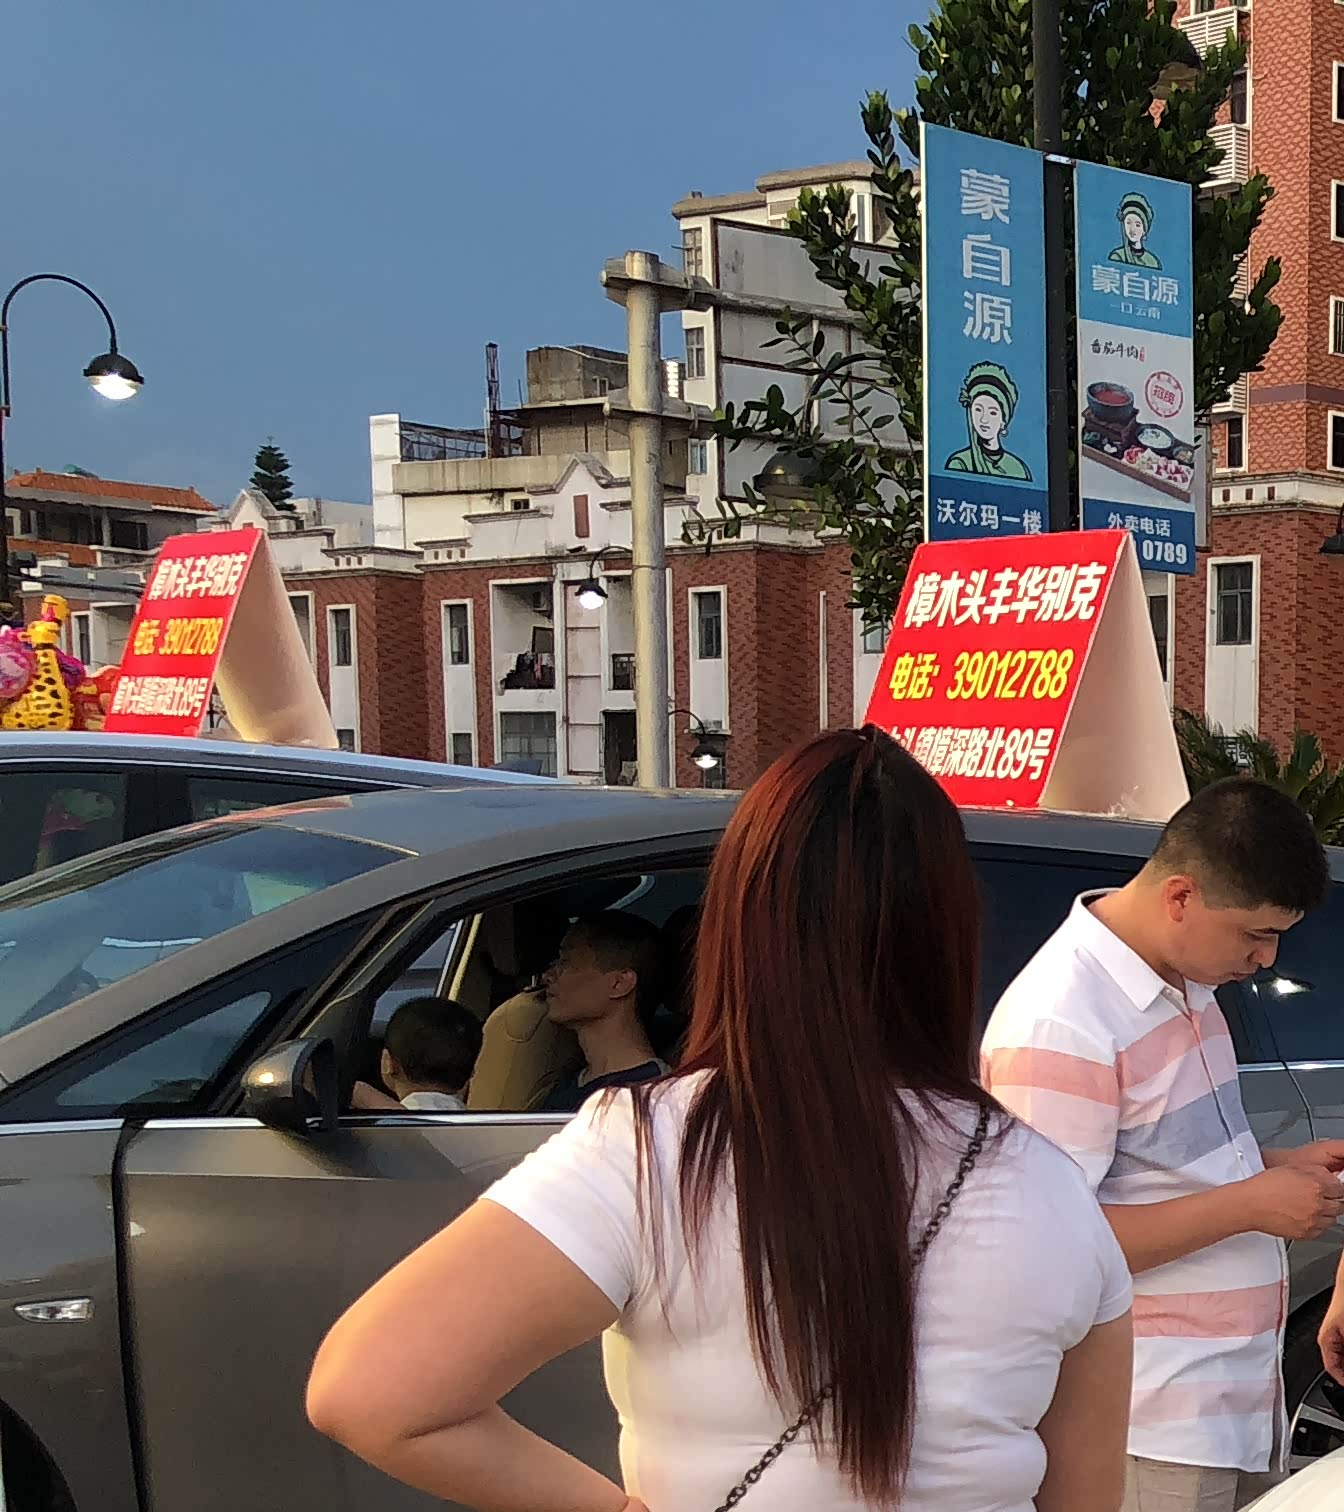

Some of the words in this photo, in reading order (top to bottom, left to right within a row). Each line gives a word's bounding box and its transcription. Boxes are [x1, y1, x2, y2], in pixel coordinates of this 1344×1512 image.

[960, 168, 1013, 346] 蒙自源
[1091, 264, 1179, 306] 蒙自源
[936, 497, 1043, 535] 沃尔玛一楼
[1107, 511, 1171, 537] 外卖电话
[904, 562, 1107, 628] 樟木头丰华别克
